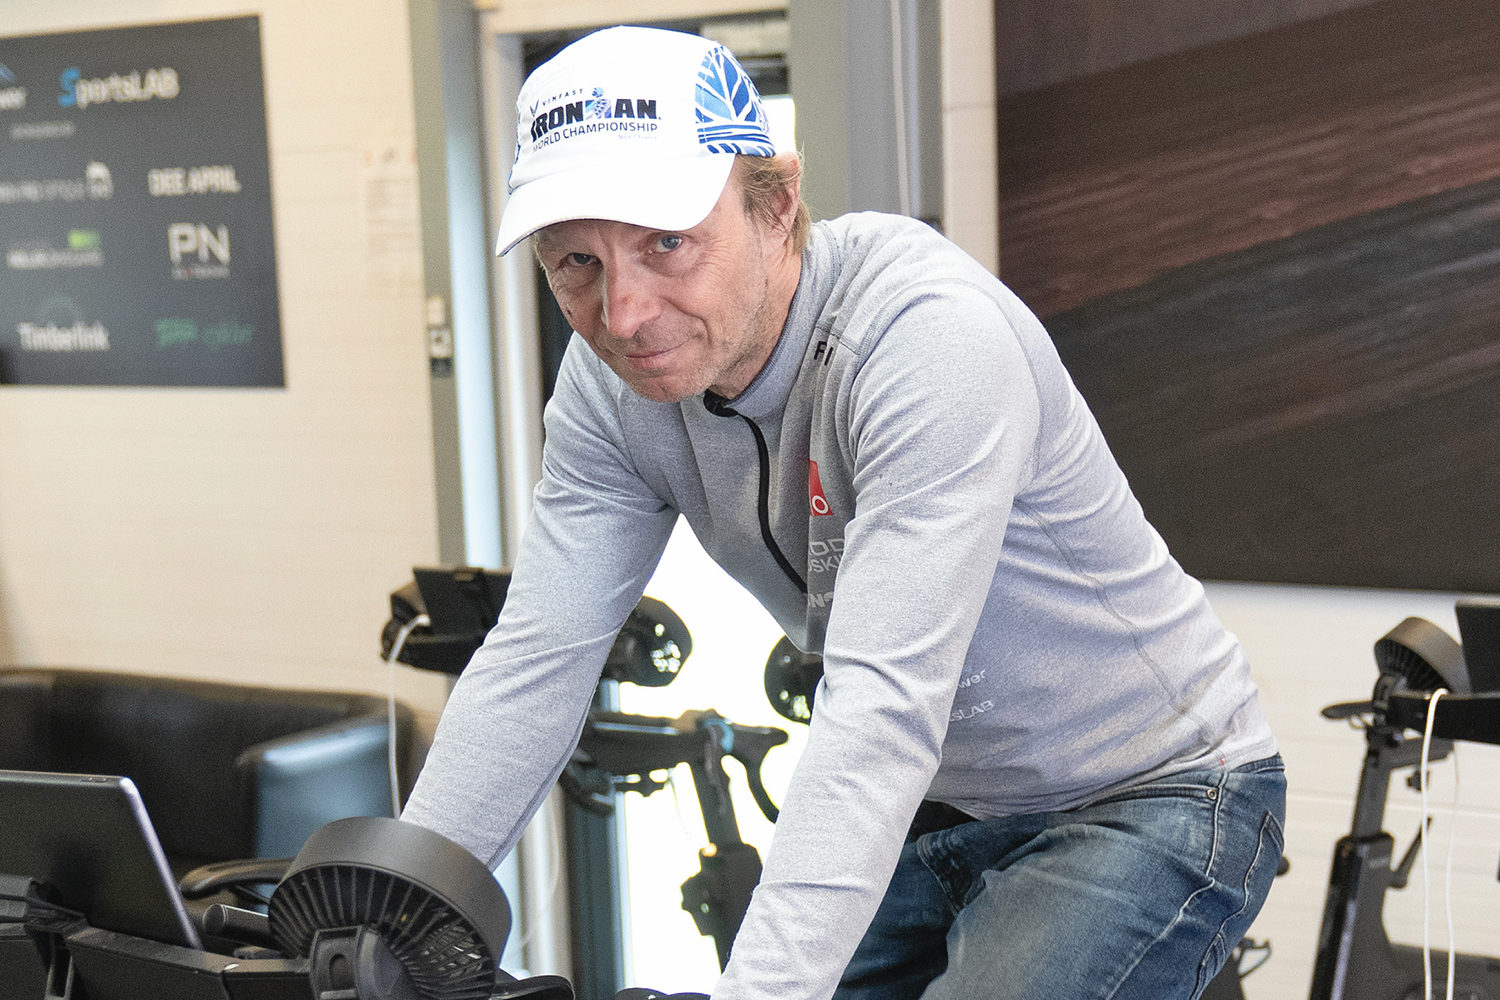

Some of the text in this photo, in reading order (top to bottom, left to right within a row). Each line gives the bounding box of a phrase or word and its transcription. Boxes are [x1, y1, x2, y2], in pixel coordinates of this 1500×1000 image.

[542, 88, 583, 106] VINFAST
[532, 121, 658, 153] WORLD CHAMPIONSHIP
[167, 222, 231, 265] PN
